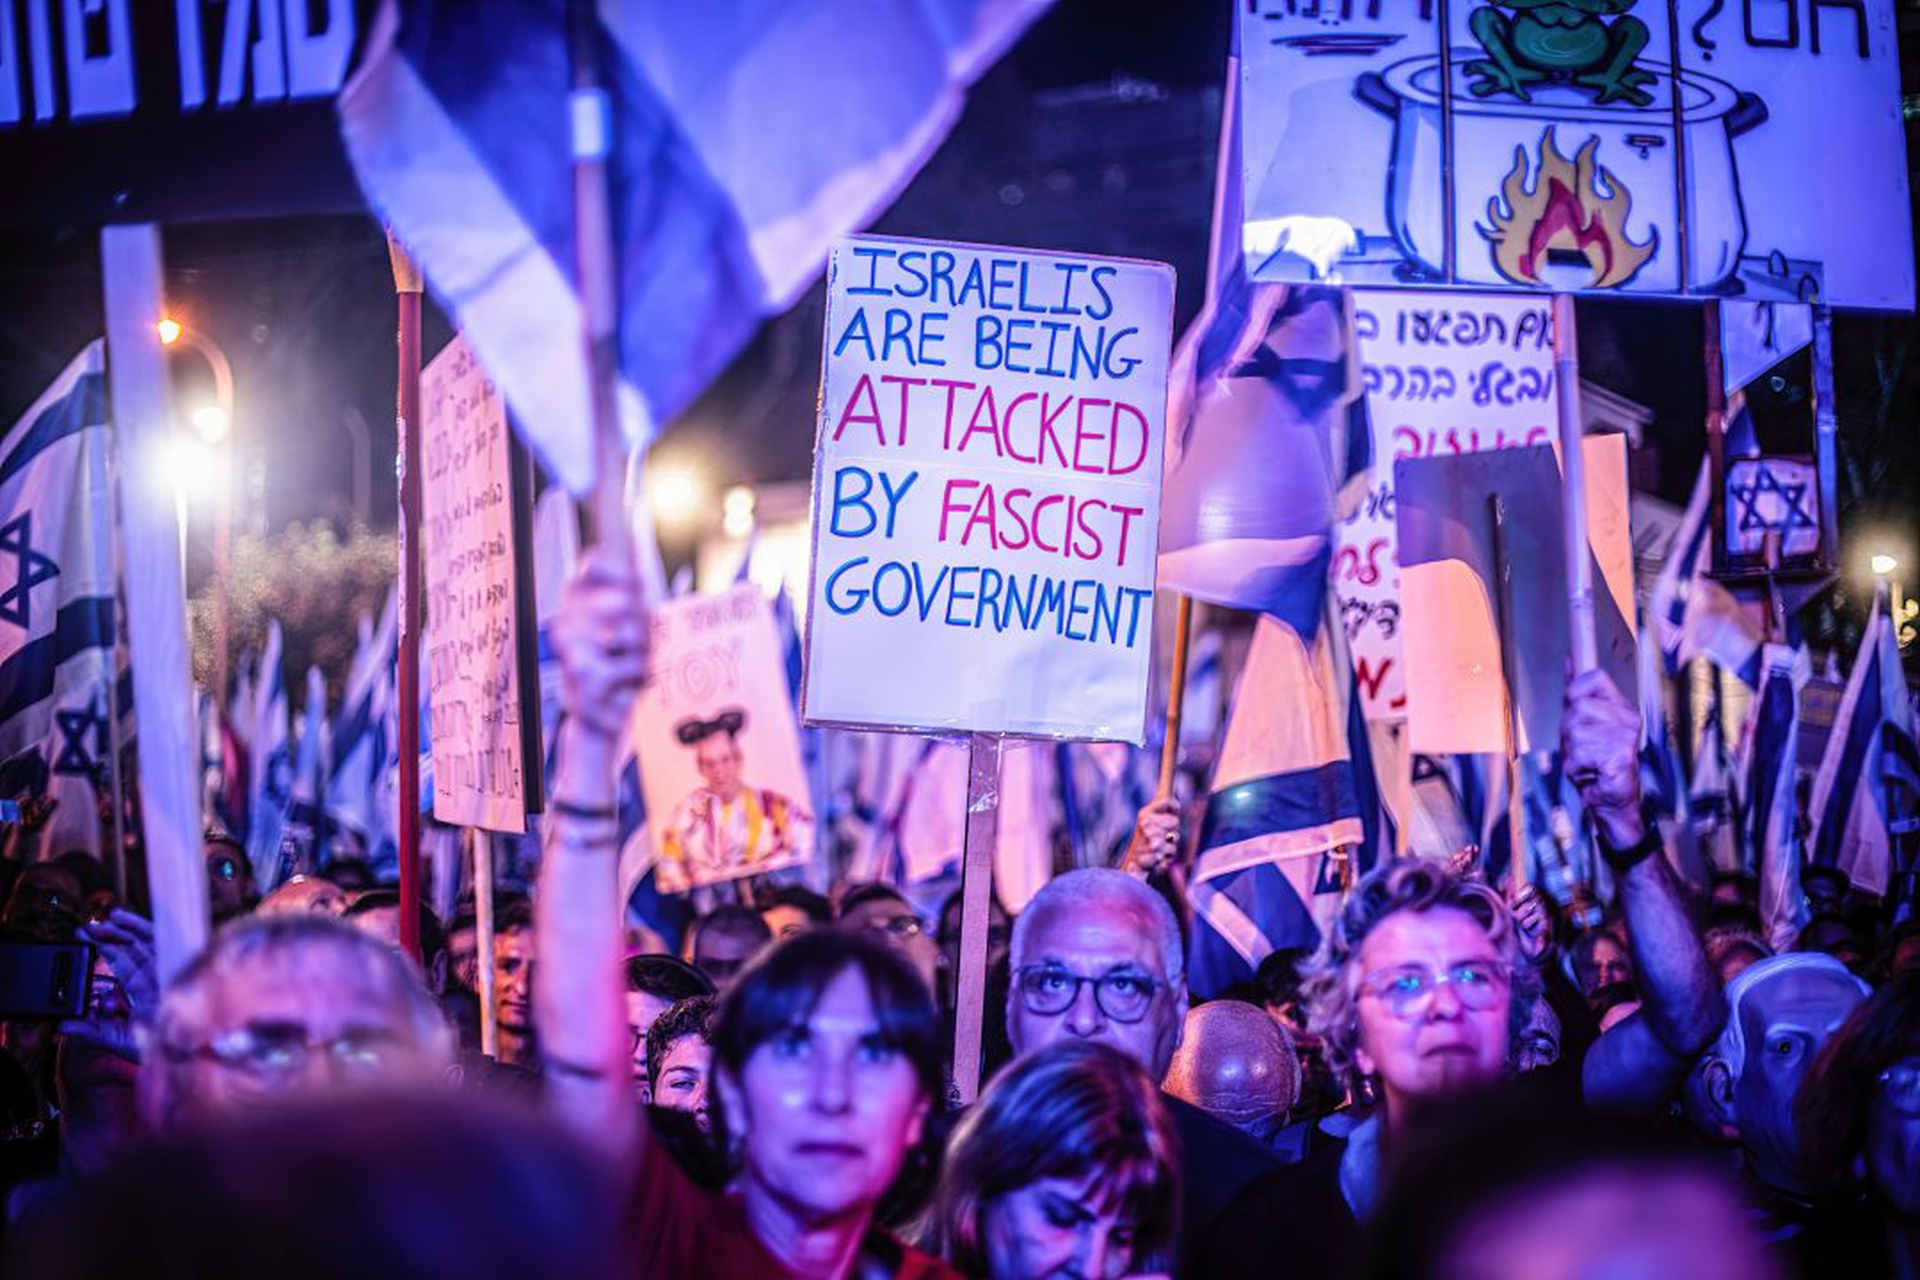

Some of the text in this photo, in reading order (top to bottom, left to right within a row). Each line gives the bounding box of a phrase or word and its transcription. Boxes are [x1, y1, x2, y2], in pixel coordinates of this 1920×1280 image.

[847, 247, 1118, 320] ISRAELIS
[834, 307, 1143, 380] ARE BEING
[832, 374, 1151, 476] ATTACKED
[829, 466, 1144, 566] BY FASCIST
[824, 556, 1153, 648] GOVERNMENT
